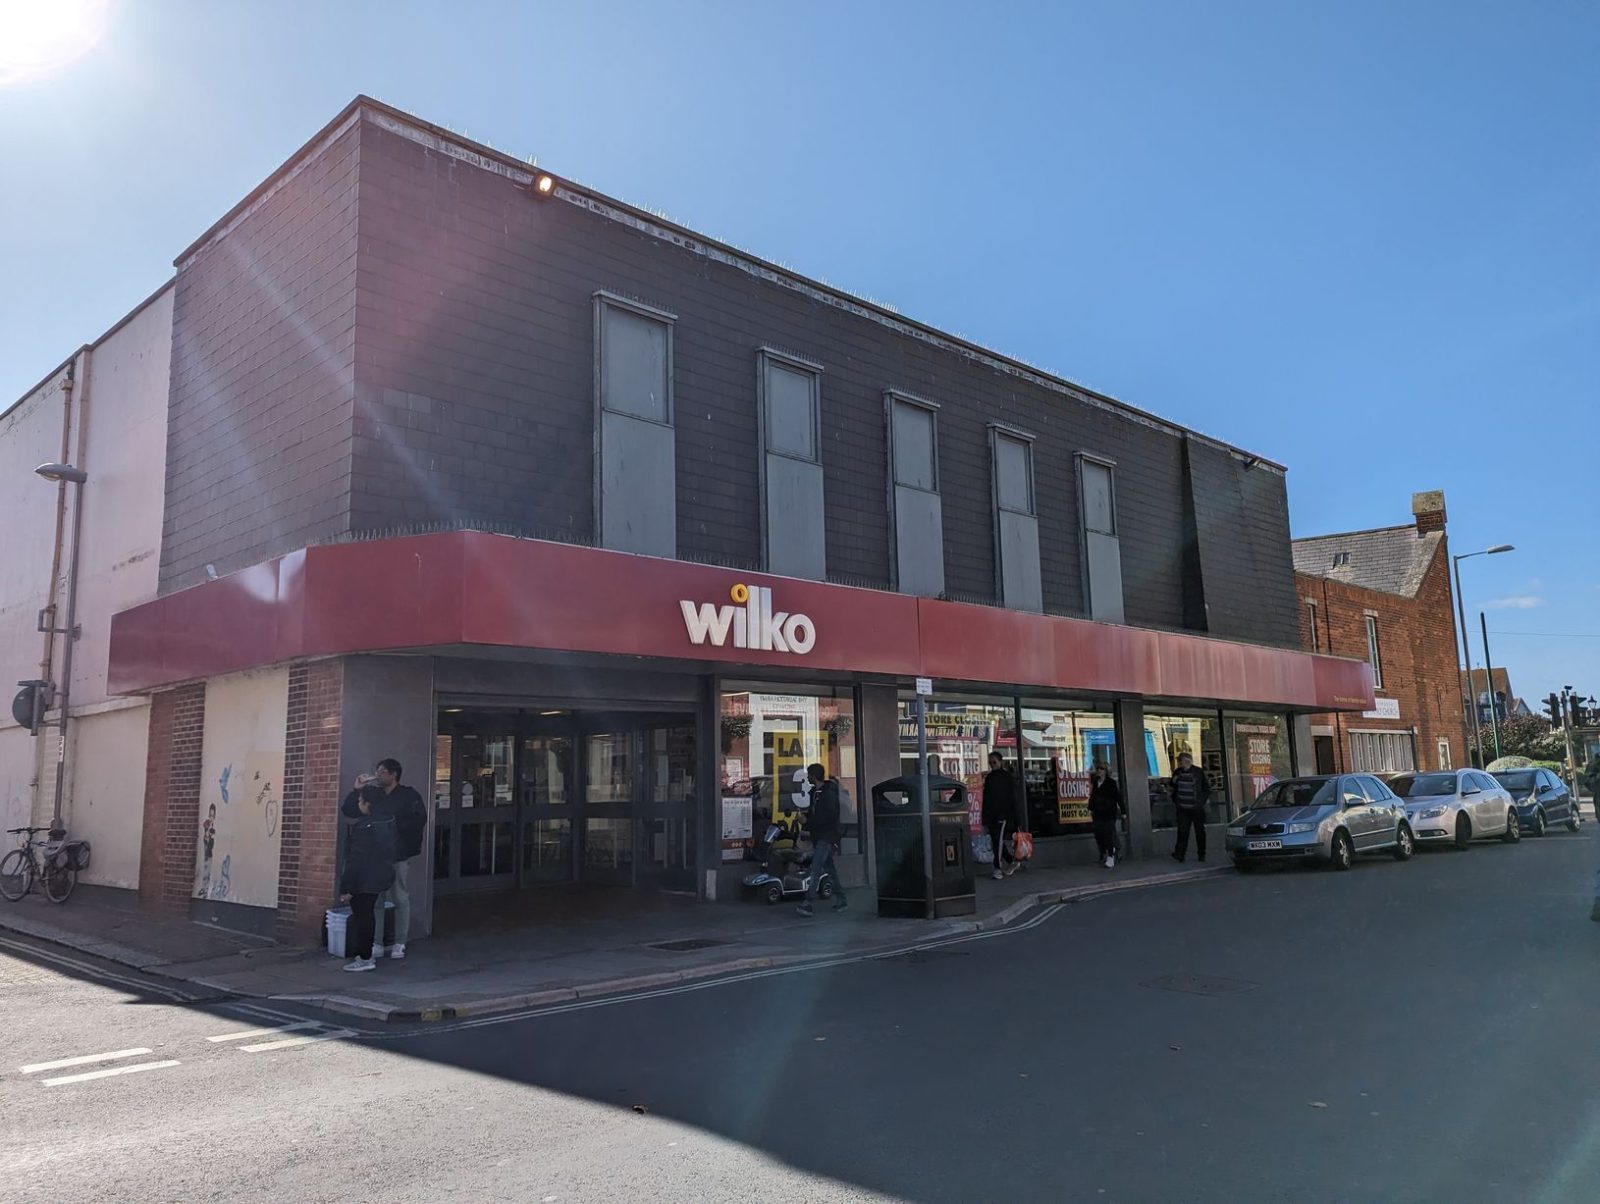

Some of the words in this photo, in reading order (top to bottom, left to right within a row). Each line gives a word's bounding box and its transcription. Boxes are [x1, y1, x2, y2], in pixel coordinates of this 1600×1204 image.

[679, 583, 816, 655] wilko
[1249, 739, 1270, 753] STORE
[1250, 754, 1271, 764] CLOSING
[1059, 780, 1090, 797] CLOSING
[969, 813, 982, 825] OFF
